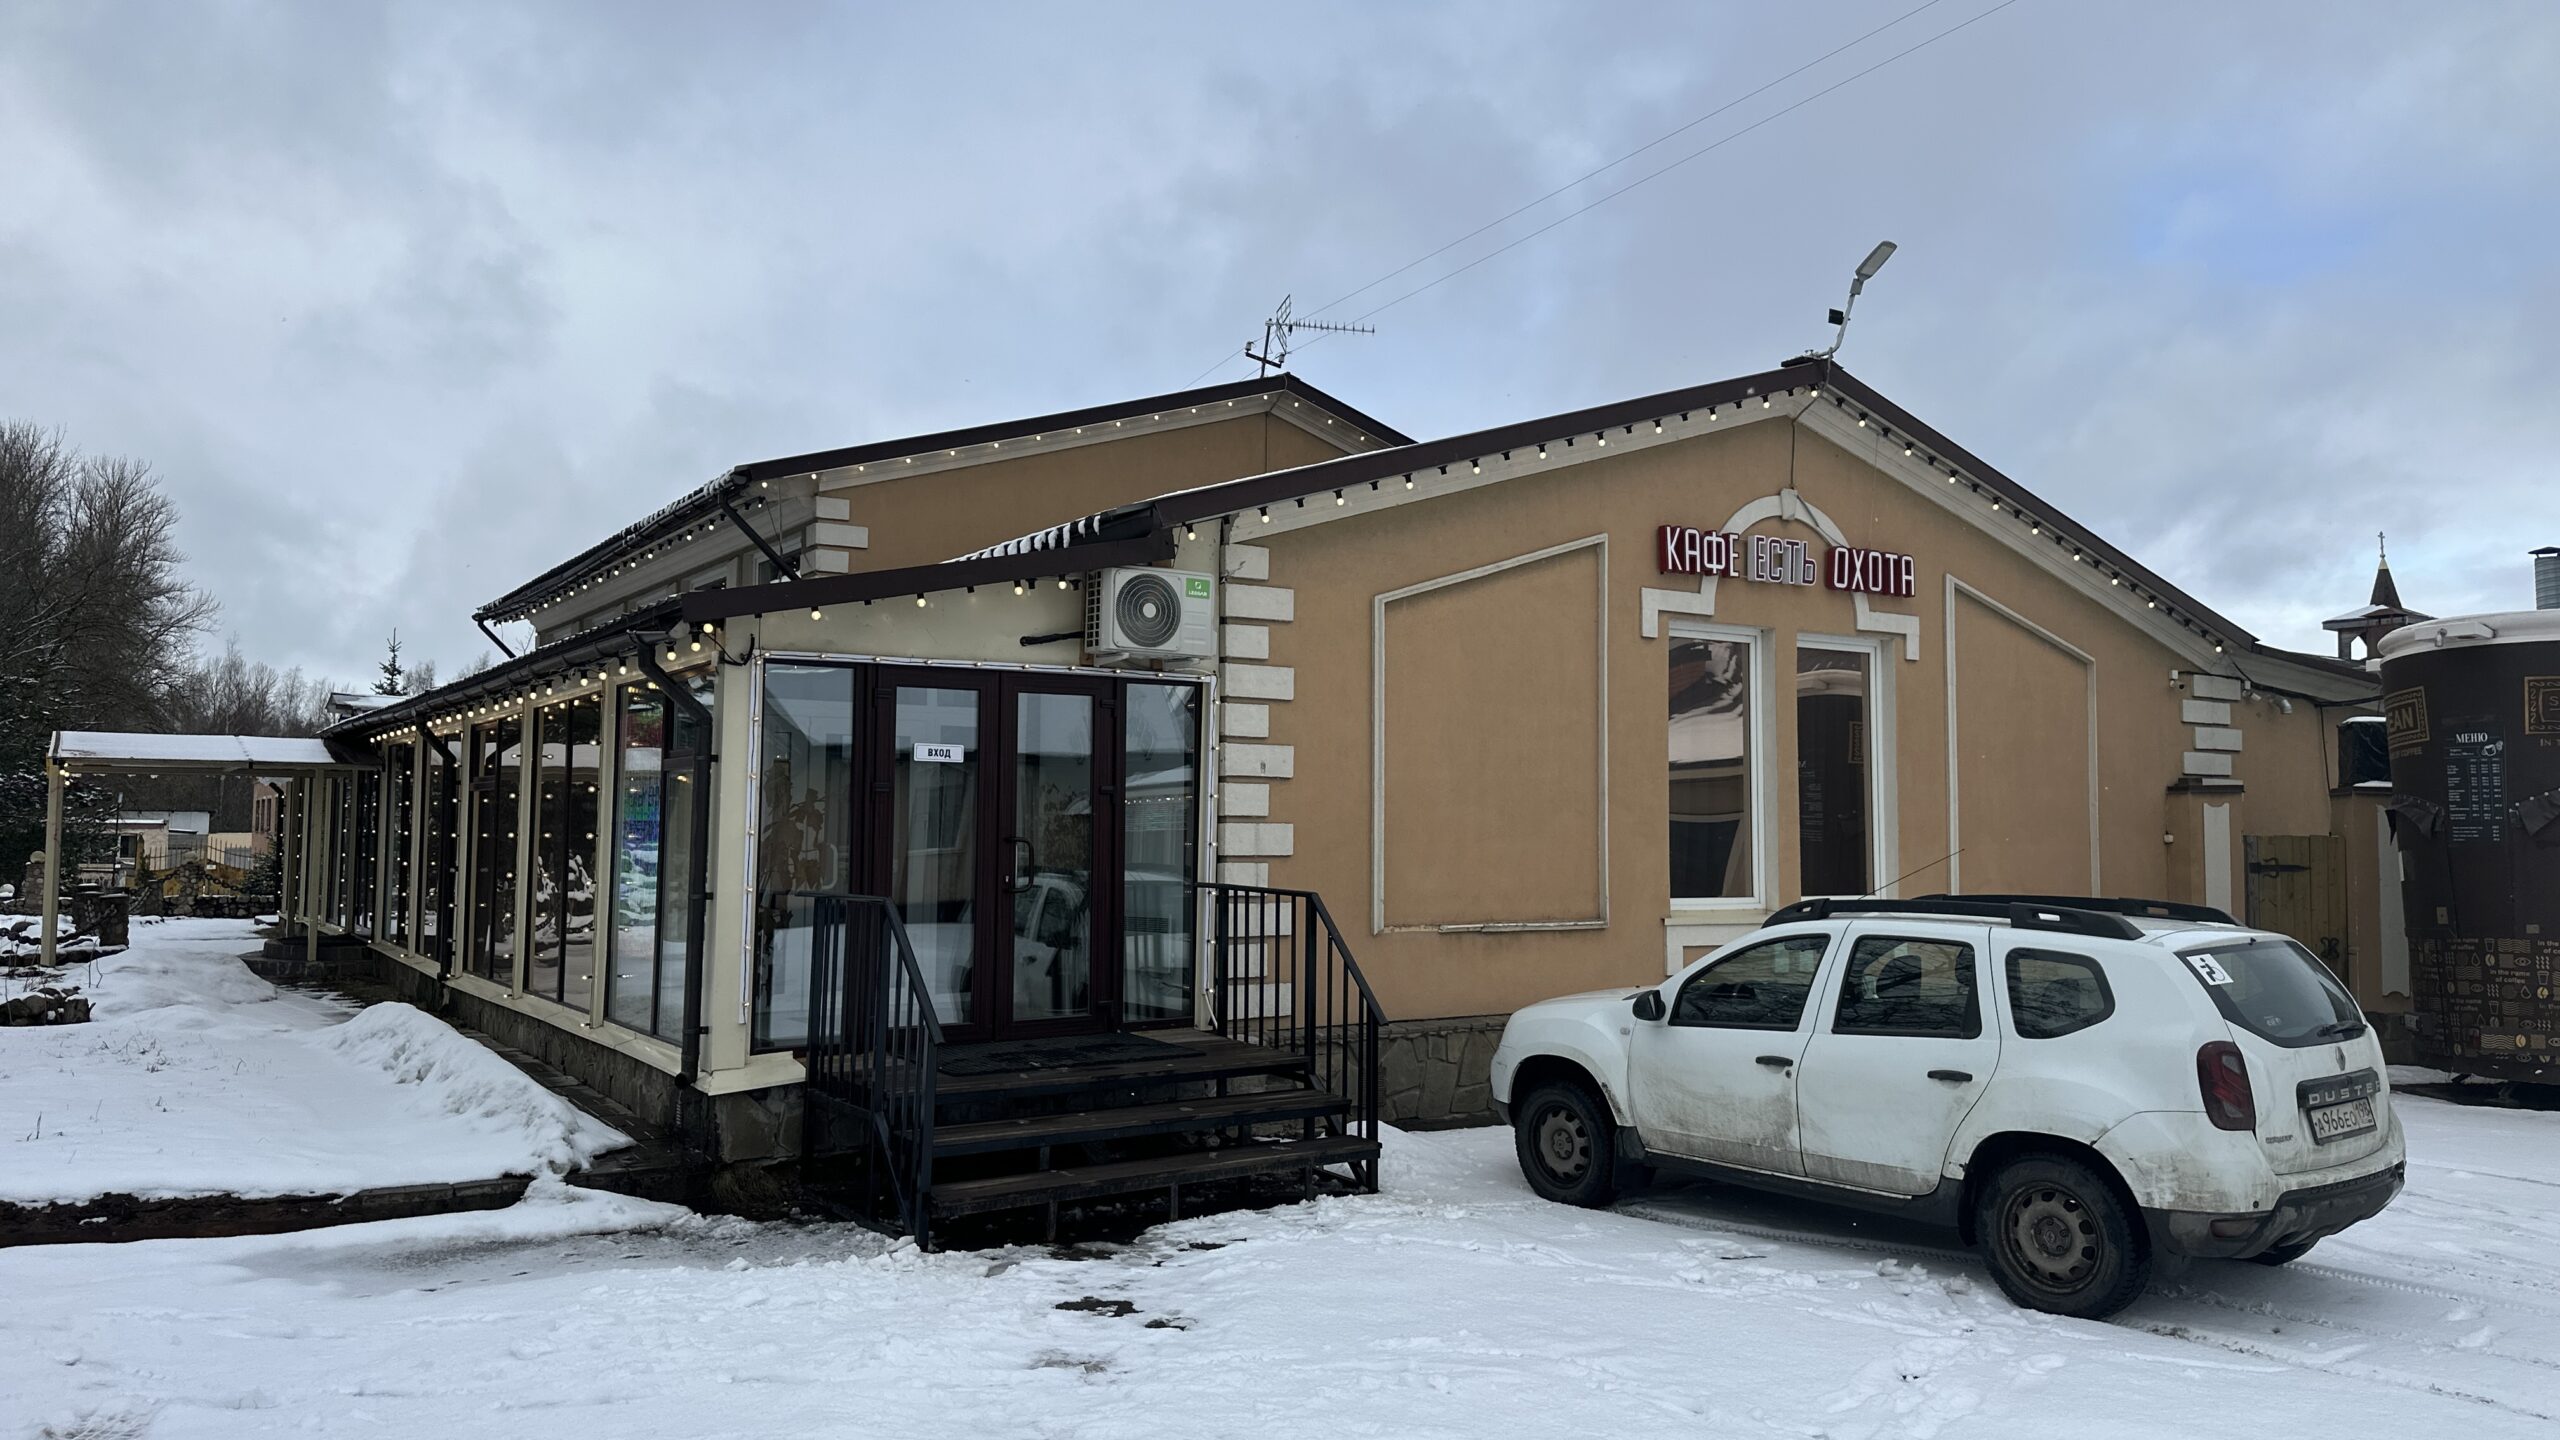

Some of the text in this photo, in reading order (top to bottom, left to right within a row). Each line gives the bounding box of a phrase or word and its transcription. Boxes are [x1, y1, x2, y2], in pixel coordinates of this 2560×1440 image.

[1664, 525, 1916, 597] КАФЕ ЕСТЬ ОХОТА
[2456, 732, 2488, 744] МЕНЮ
[927, 748, 951, 759] ВХОД
